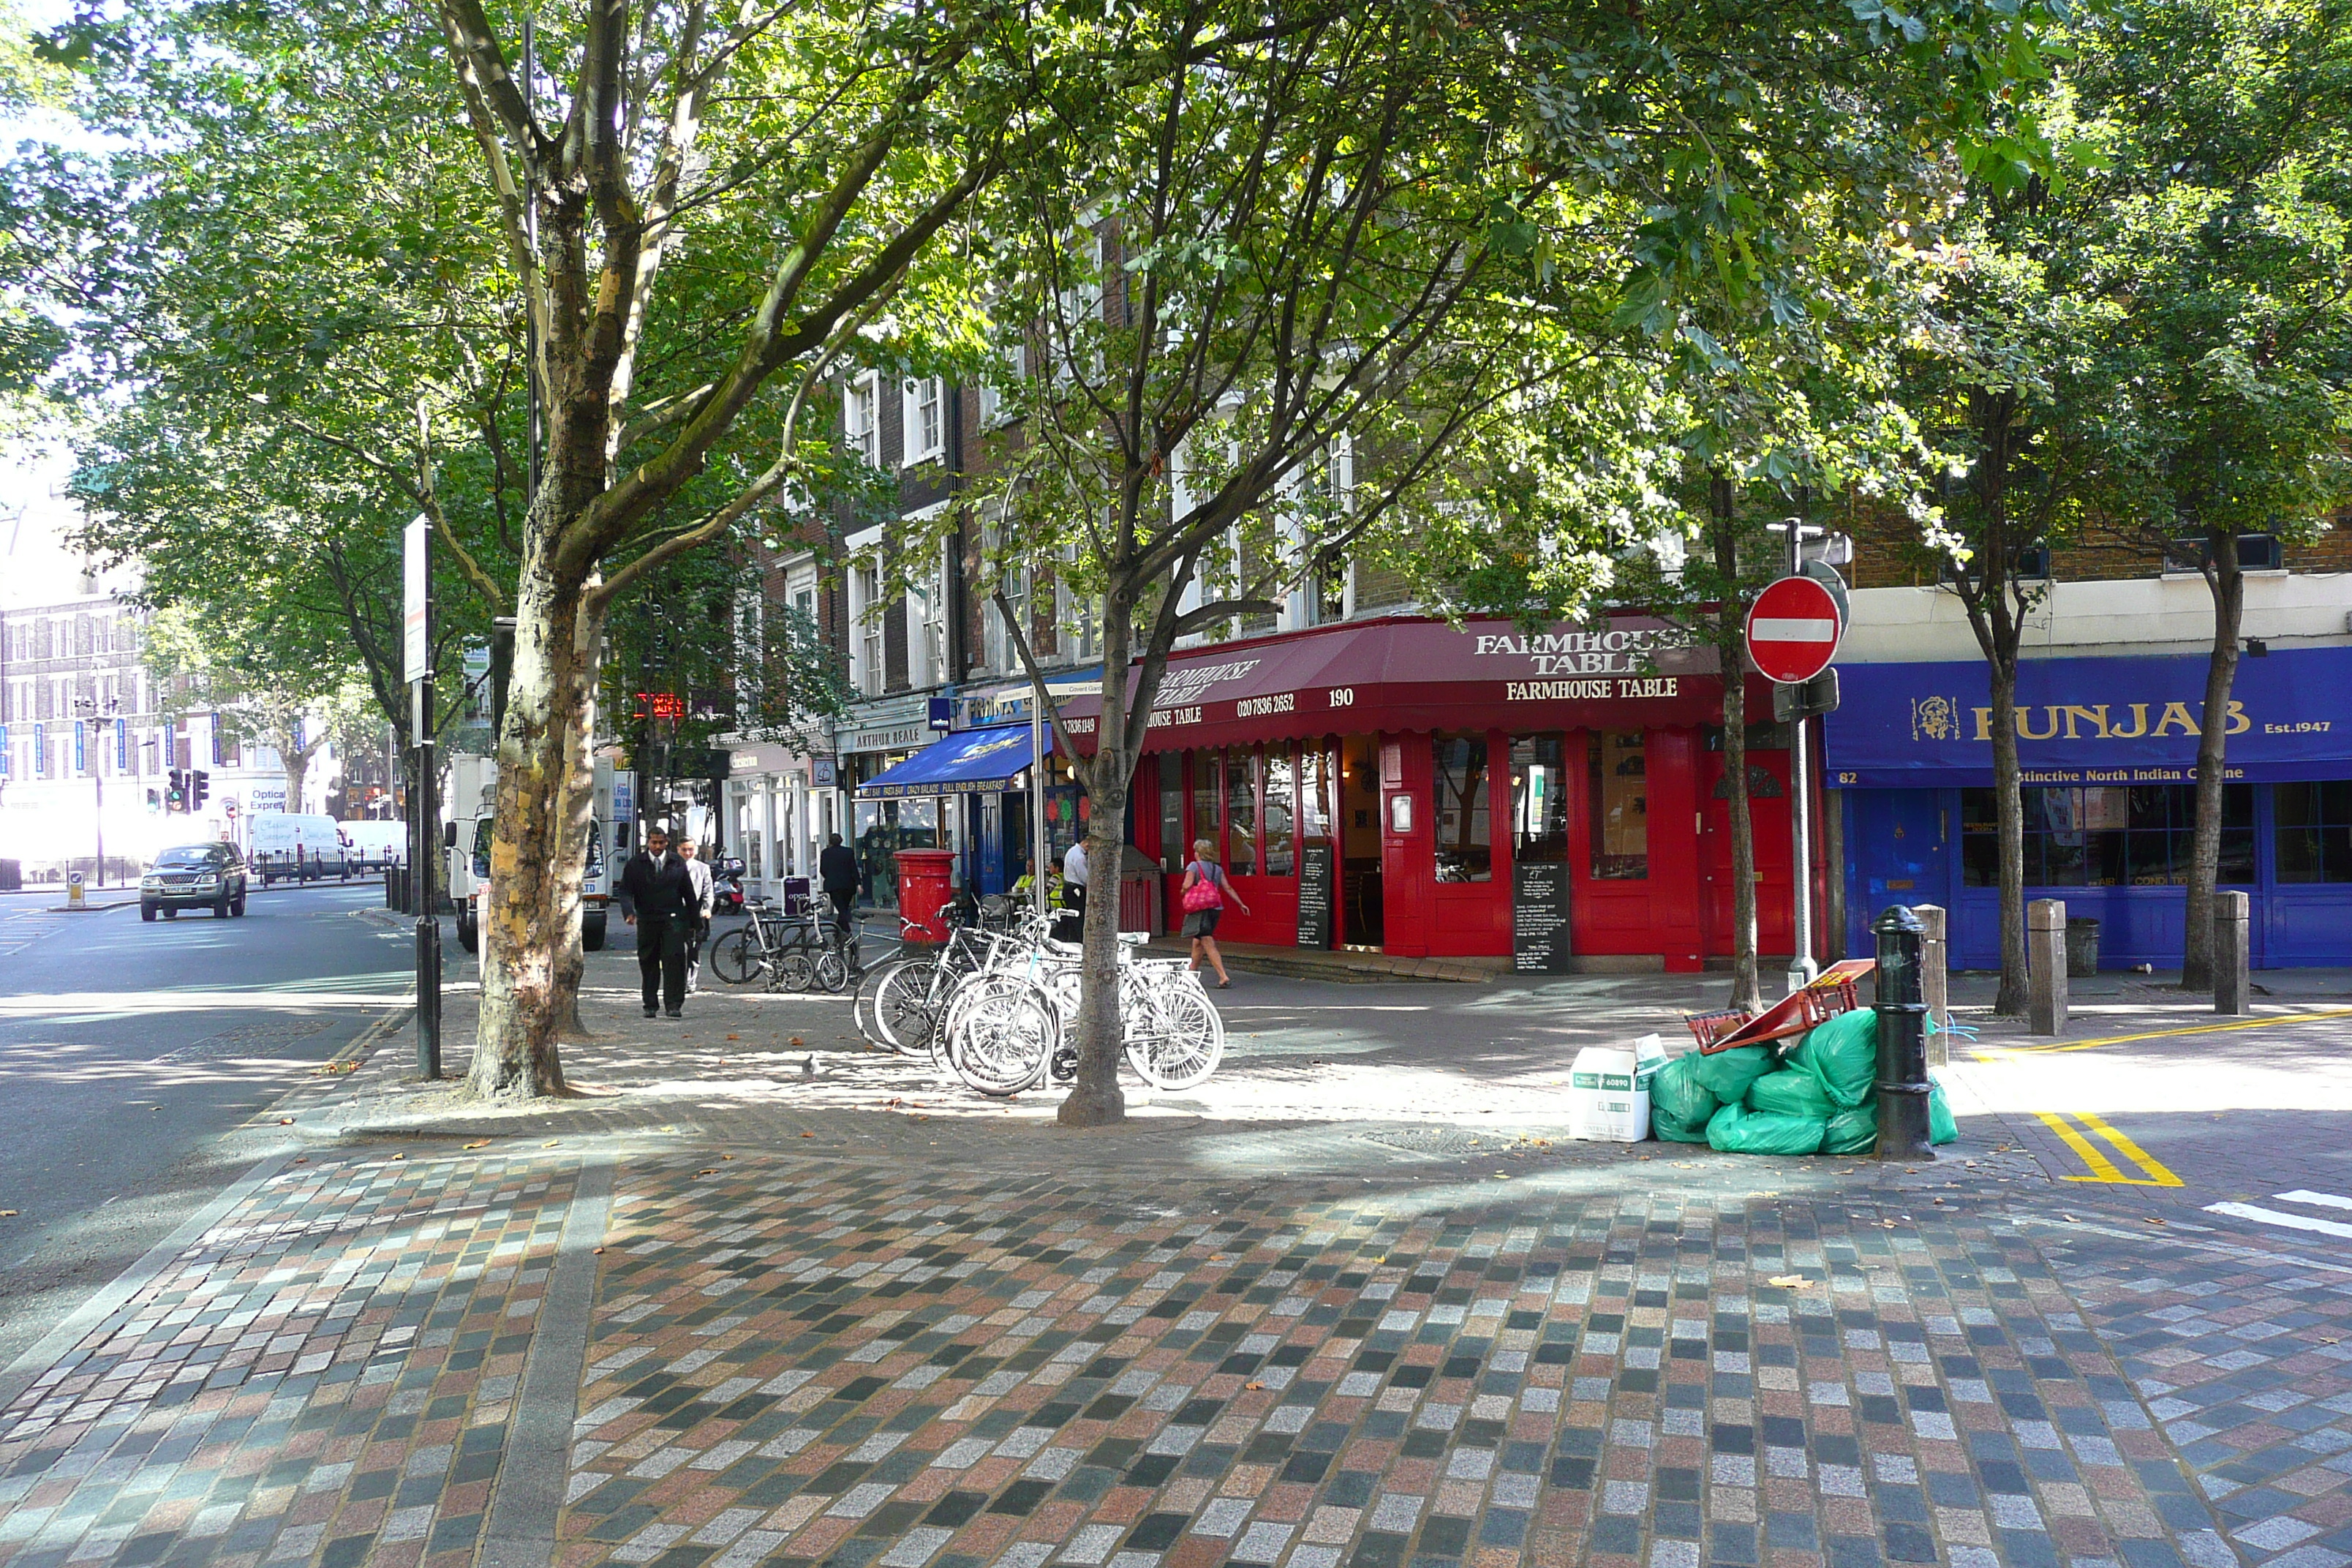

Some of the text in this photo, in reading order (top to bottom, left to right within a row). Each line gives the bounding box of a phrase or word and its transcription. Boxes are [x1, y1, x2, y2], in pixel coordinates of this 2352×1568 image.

[1530, 652, 1649, 675] TABLE
[1329, 688, 1354, 707] 190
[1507, 677, 1678, 701] FARMHOUSE TABLE
[1237, 693, 1294, 717] 020 7836 2652
[1175, 706, 1202, 725] TABLE
[1971, 700, 2251, 741] PUNJAB
[2264, 721, 2331, 734] Est.1947
[856, 728, 919, 747] ARTHUR BEALE
[1839, 772, 1857, 784] 82
[2019, 770, 2079, 783] stinctive
[2086, 769, 2127, 782] North
[2134, 768, 2181, 780] Indian
[252, 790, 286, 800] Optical
[943, 783, 954, 792] FULL
[955, 782, 976, 792] ENGLISH
[977, 780, 1006, 791] BREAKFAST
[250, 800, 286, 811] Expres
